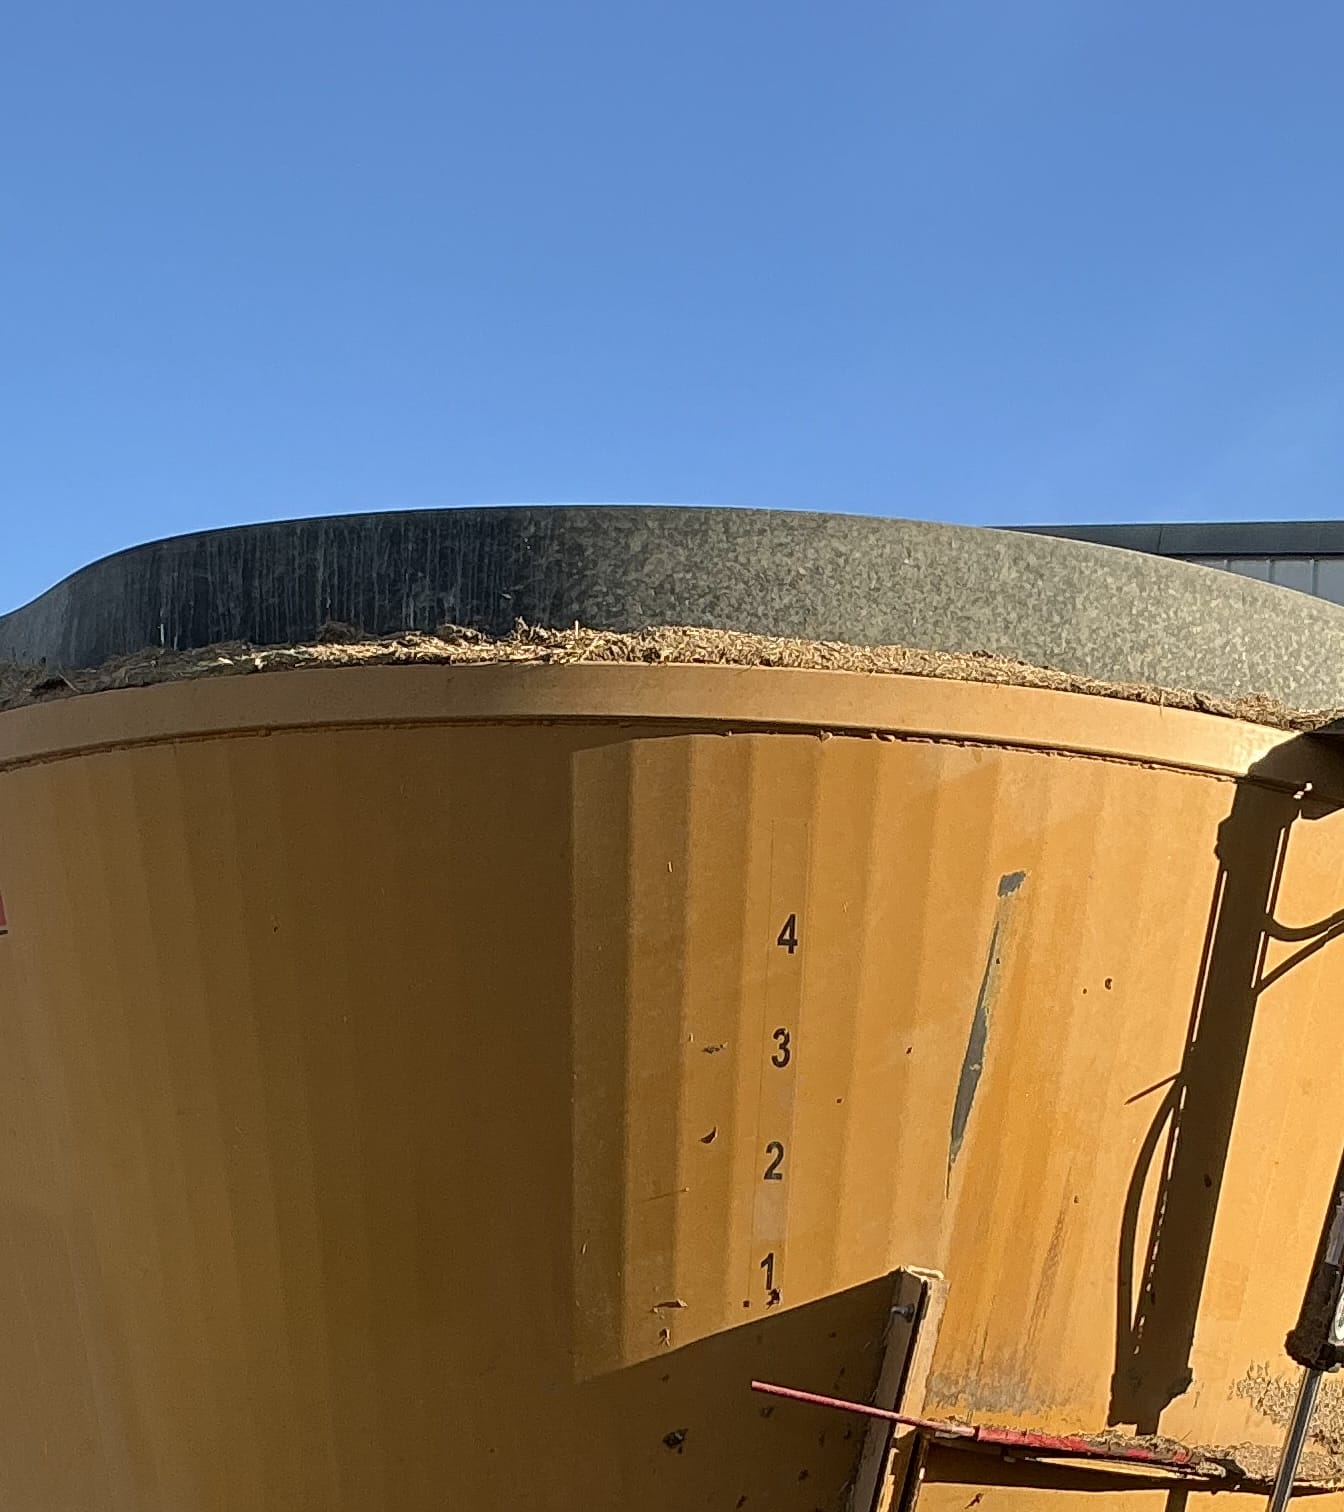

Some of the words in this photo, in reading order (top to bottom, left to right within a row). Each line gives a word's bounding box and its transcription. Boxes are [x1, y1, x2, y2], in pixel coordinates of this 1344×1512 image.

[776, 913, 799, 955] 4
[770, 1027, 792, 1069] 3
[762, 1141, 784, 1181] 2
[760, 1252, 777, 1291] 1
